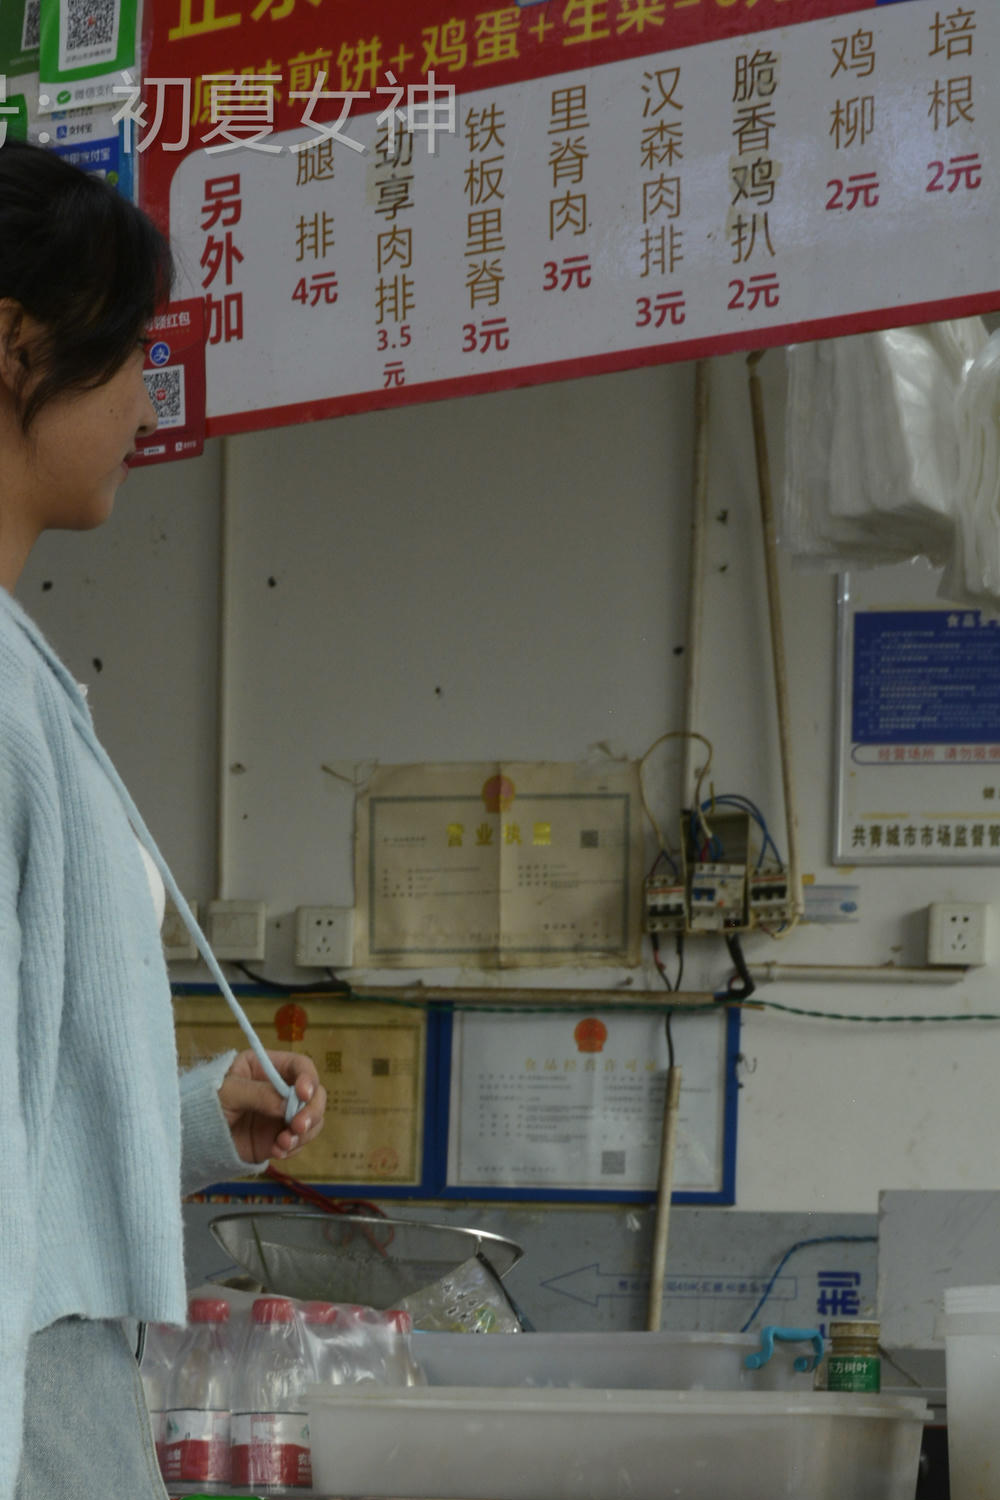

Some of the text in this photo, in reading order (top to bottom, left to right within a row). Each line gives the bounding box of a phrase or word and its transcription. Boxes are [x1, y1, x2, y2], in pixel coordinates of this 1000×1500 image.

[190, 0, 700, 127] 原味煎饼+鸡蛋+生菜
[829, 28, 876, 150] 鸡柳
[928, 7, 976, 131] 培根
[548, 84, 591, 241] 里脊肉
[640, 66, 684, 278] 汉森肉排
[731, 49, 777, 265] 脆香鸡扒
[825, 172, 880, 210] 2元
[926, 153, 982, 194] 2元
[374, 123, 416, 325] 劲享肉排
[464, 103, 506, 310] 铁板里脊
[202, 173, 244, 346] 另外加
[292, 271, 338, 307] 4元
[542, 255, 592, 292] 3元
[727, 273, 780, 311] 2元
[376, 326, 413, 352] 3.5
[462, 318, 510, 353] 3元
[635, 290, 686, 328] 3元
[446, 821, 552, 848] 营业执照
